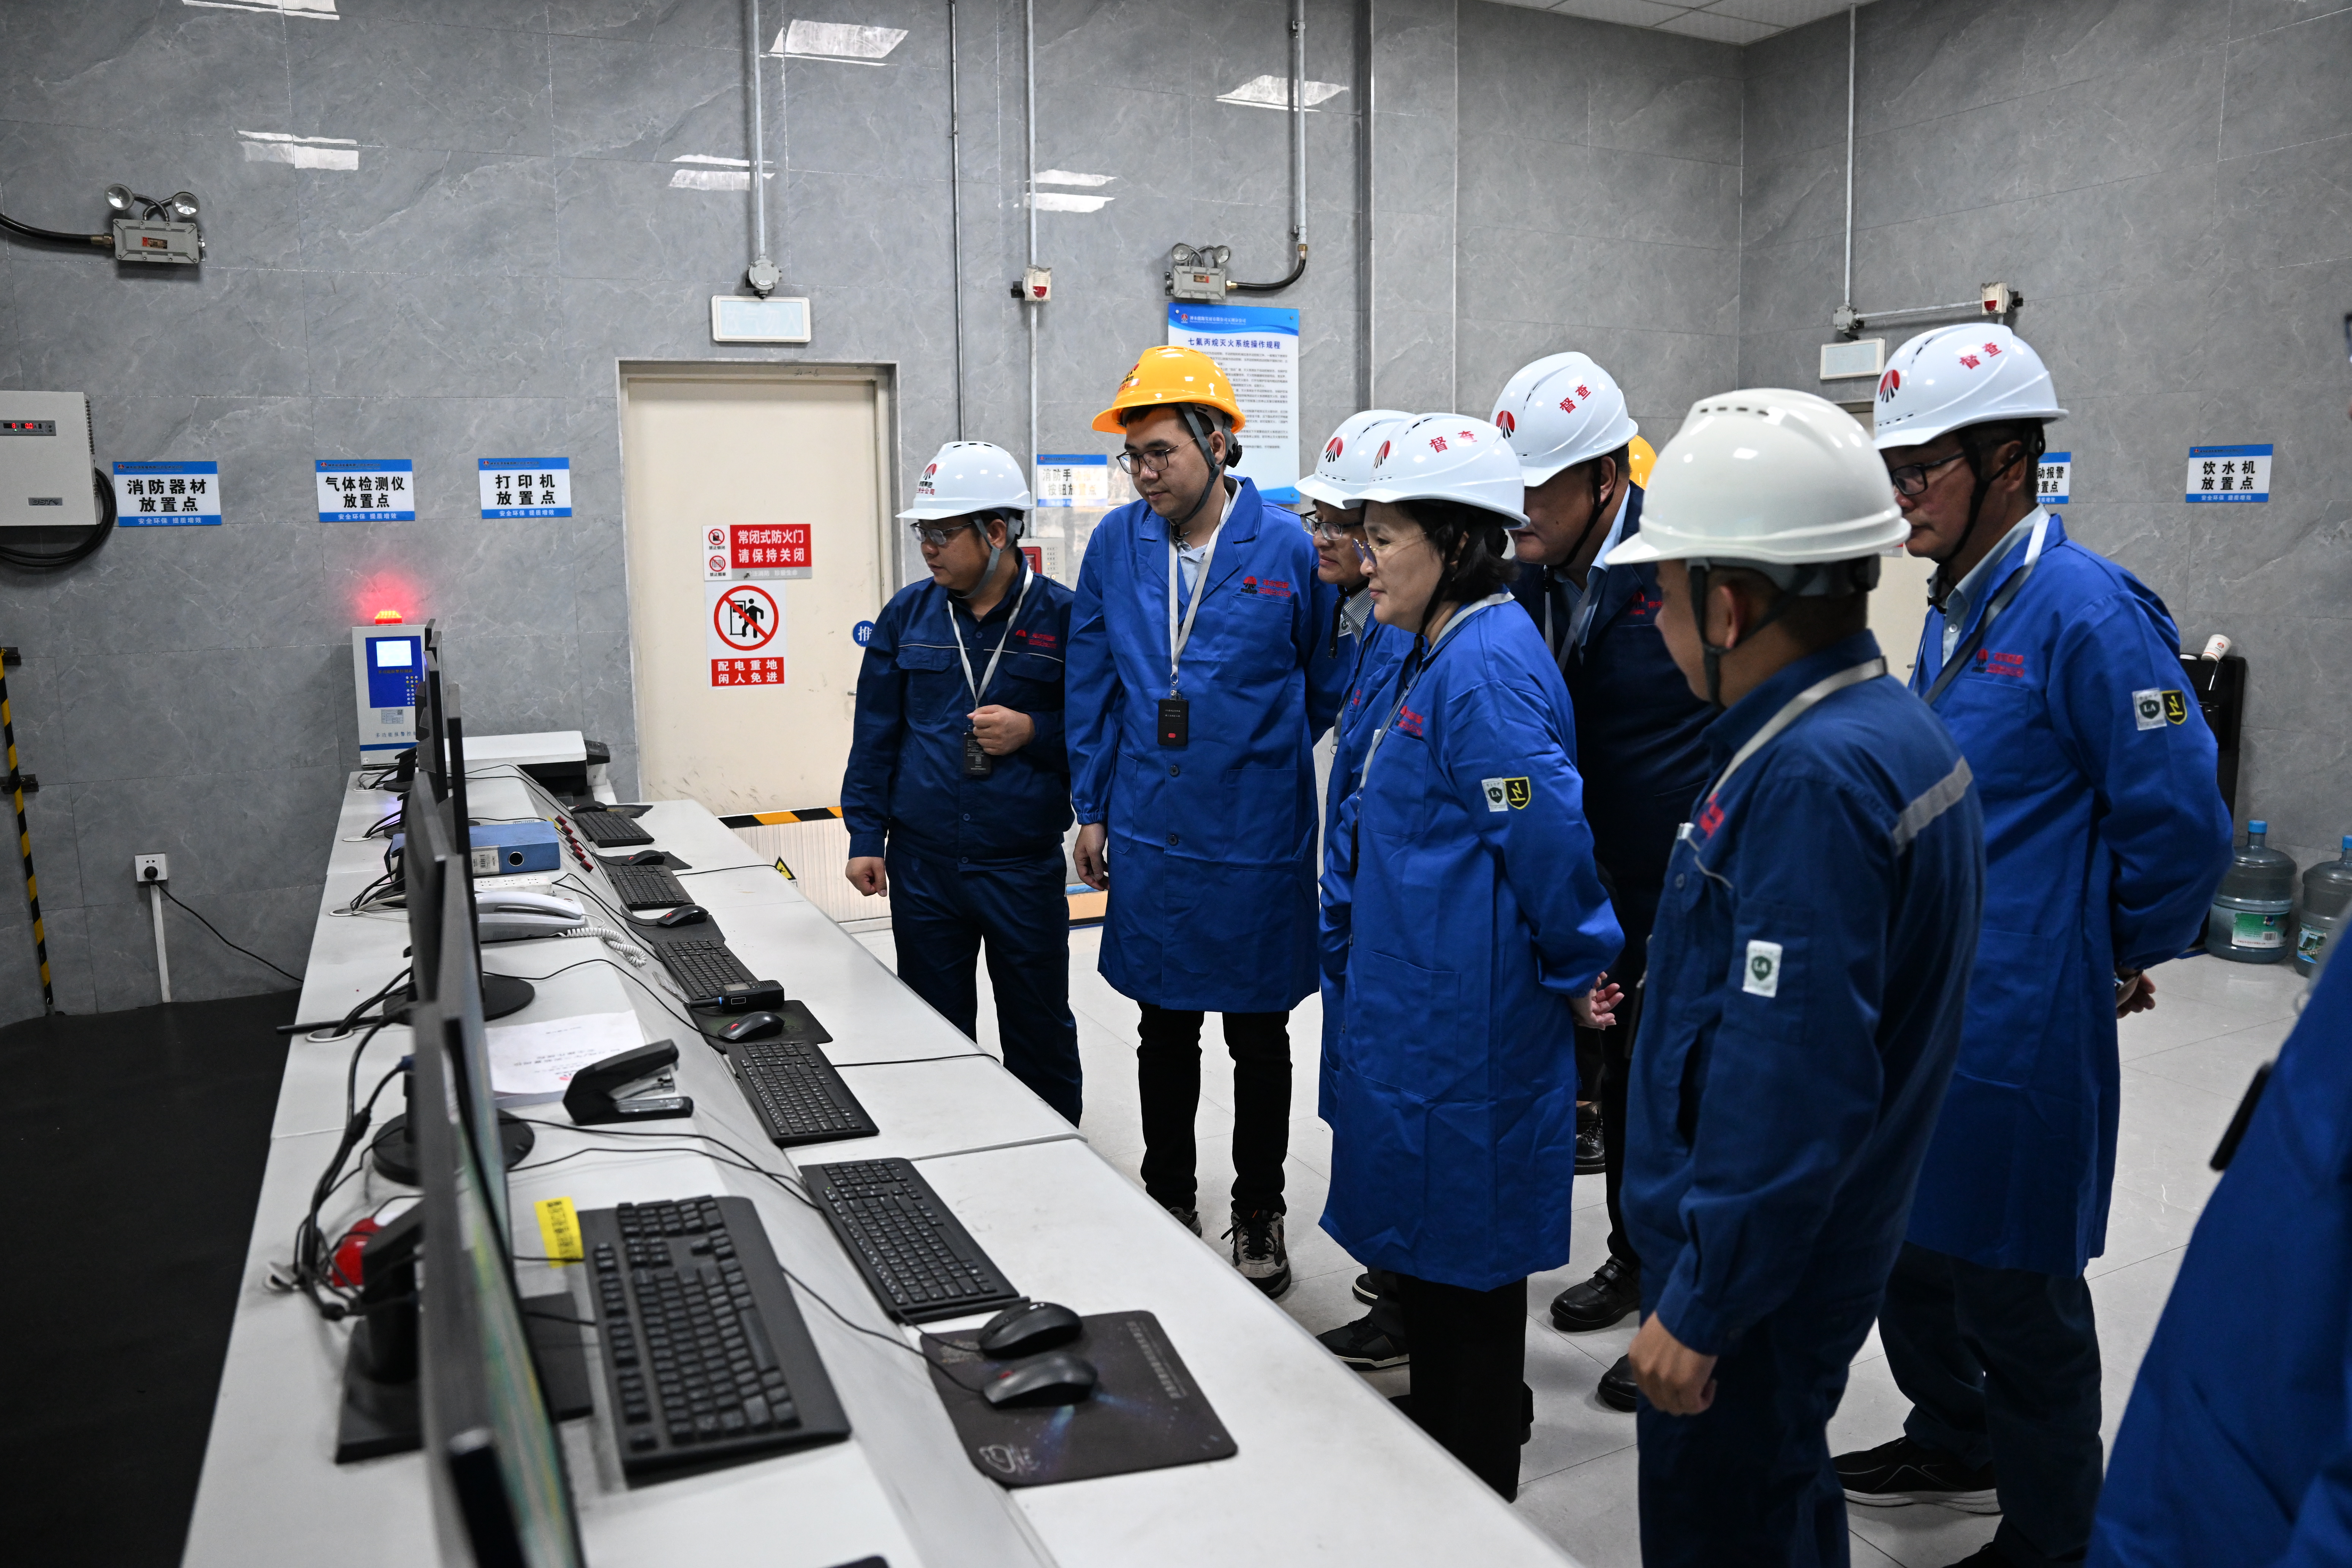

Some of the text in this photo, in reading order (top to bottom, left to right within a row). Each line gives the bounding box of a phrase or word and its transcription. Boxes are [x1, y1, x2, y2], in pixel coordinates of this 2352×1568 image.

[1188, 338, 1280, 349] 七氟丙烷灭火系统操作规程
[1959, 342, 2002, 370] 督查
[1559, 384, 1591, 414] 督查
[1429, 431, 1477, 453] 督查
[1043, 468, 1101, 481] 消防手动报
[2203, 460, 2256, 475] 饮水机
[127, 479, 206, 495] 消防器材
[326, 476, 405, 492] 气体检测仪
[495, 474, 555, 489] 打印机
[2201, 476, 2254, 490] 放置点
[1048, 483, 1097, 496] 按钮放置点
[139, 496, 198, 512] 放置点
[343, 493, 390, 508] 放置点
[496, 490, 556, 505] 放置点
[738, 530, 804, 545] 常闭式防火门
[738, 548, 805, 563] 请保持关闭
[858, 626, 873, 642] 推
[718, 659, 778, 672] 配电重地
[718, 672, 778, 684] 闲人免进
[2143, 703, 2156, 713] LA
